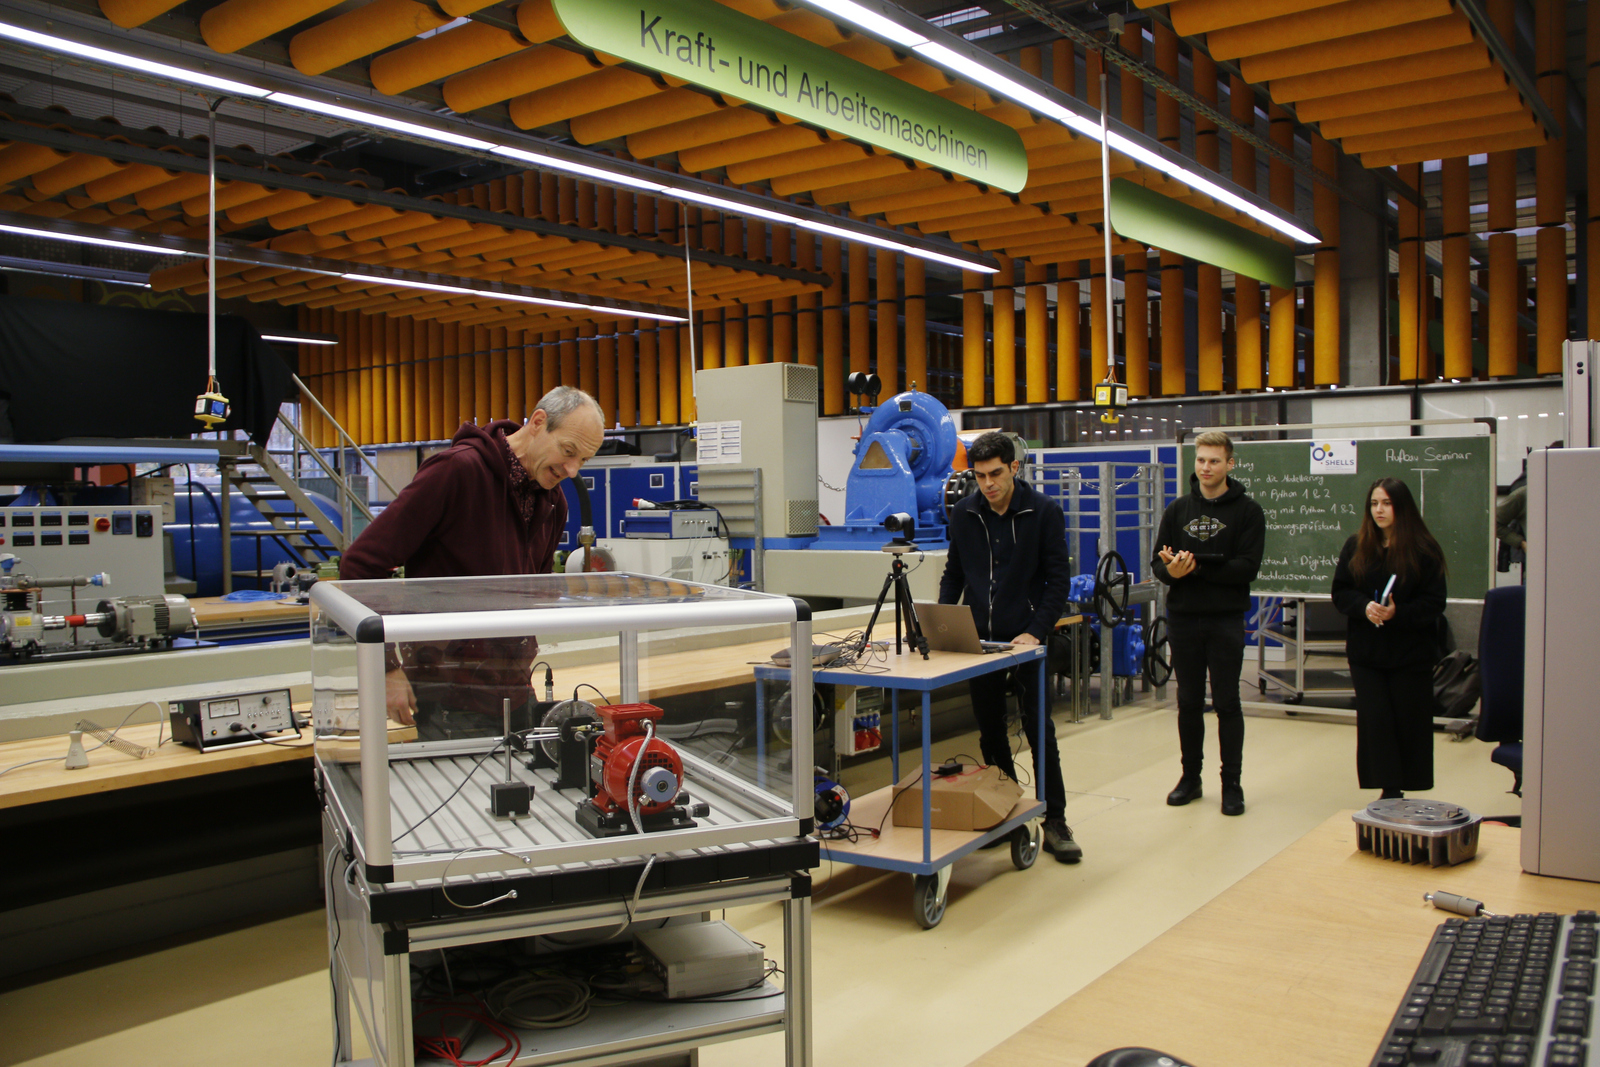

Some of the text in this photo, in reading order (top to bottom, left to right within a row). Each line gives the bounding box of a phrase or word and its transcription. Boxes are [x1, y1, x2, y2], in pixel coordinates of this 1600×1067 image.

[639, 9, 989, 172] Kraft- und Arbeitsmaschinen
[1385, 446, 1472, 463] Aufbau Seminar
[1265, 473, 1278, 483] die
[1280, 473, 1324, 485] Modellierung
[1270, 488, 1297, 501] Python
[1301, 488, 1308, 499] 1
[1312, 488, 1321, 498] &
[1324, 488, 1331, 498] 2
[1279, 505, 1295, 514] mit
[1299, 504, 1325, 515] Python
[1330, 503, 1336, 514] 1
[1264, 519, 1341, 535] trömungsprüfstand
[1261, 556, 1288, 565] stand
